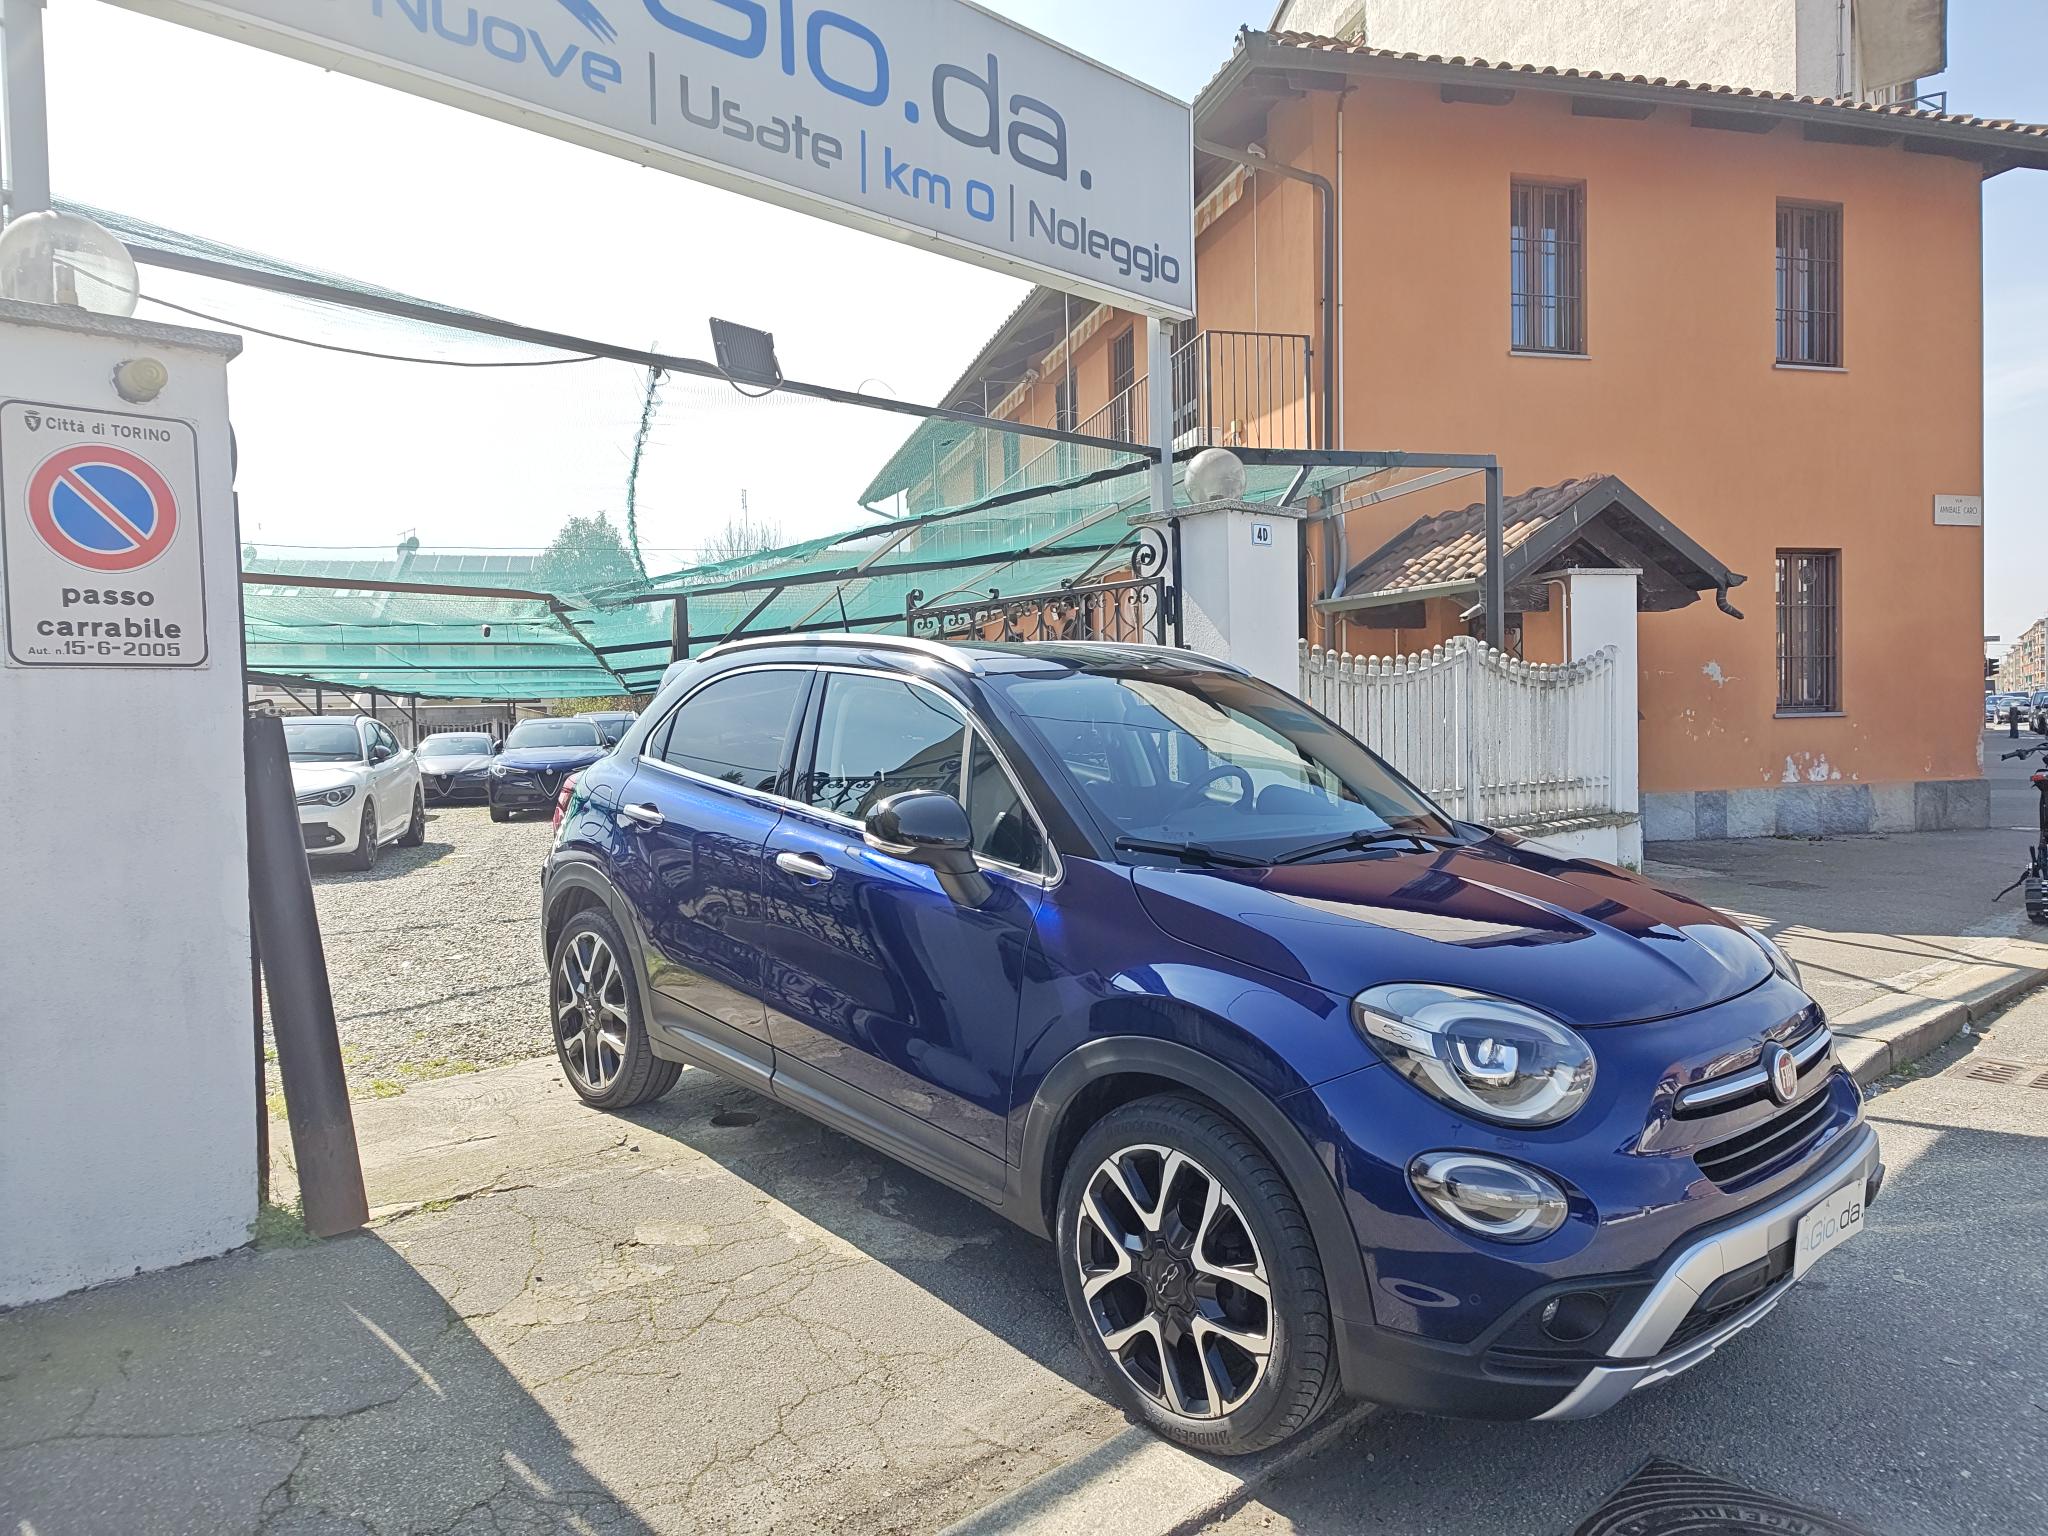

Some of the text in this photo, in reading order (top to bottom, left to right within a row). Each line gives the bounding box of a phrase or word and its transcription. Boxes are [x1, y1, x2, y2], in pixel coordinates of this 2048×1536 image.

[679, 73, 843, 170] Usate
[884, 146, 951, 209] km
[1029, 199, 1181, 284] Noleggio
[45, 417, 172, 442] Città di TORINO
[62, 587, 155, 608] passo
[36, 617, 182, 639] carrabile
